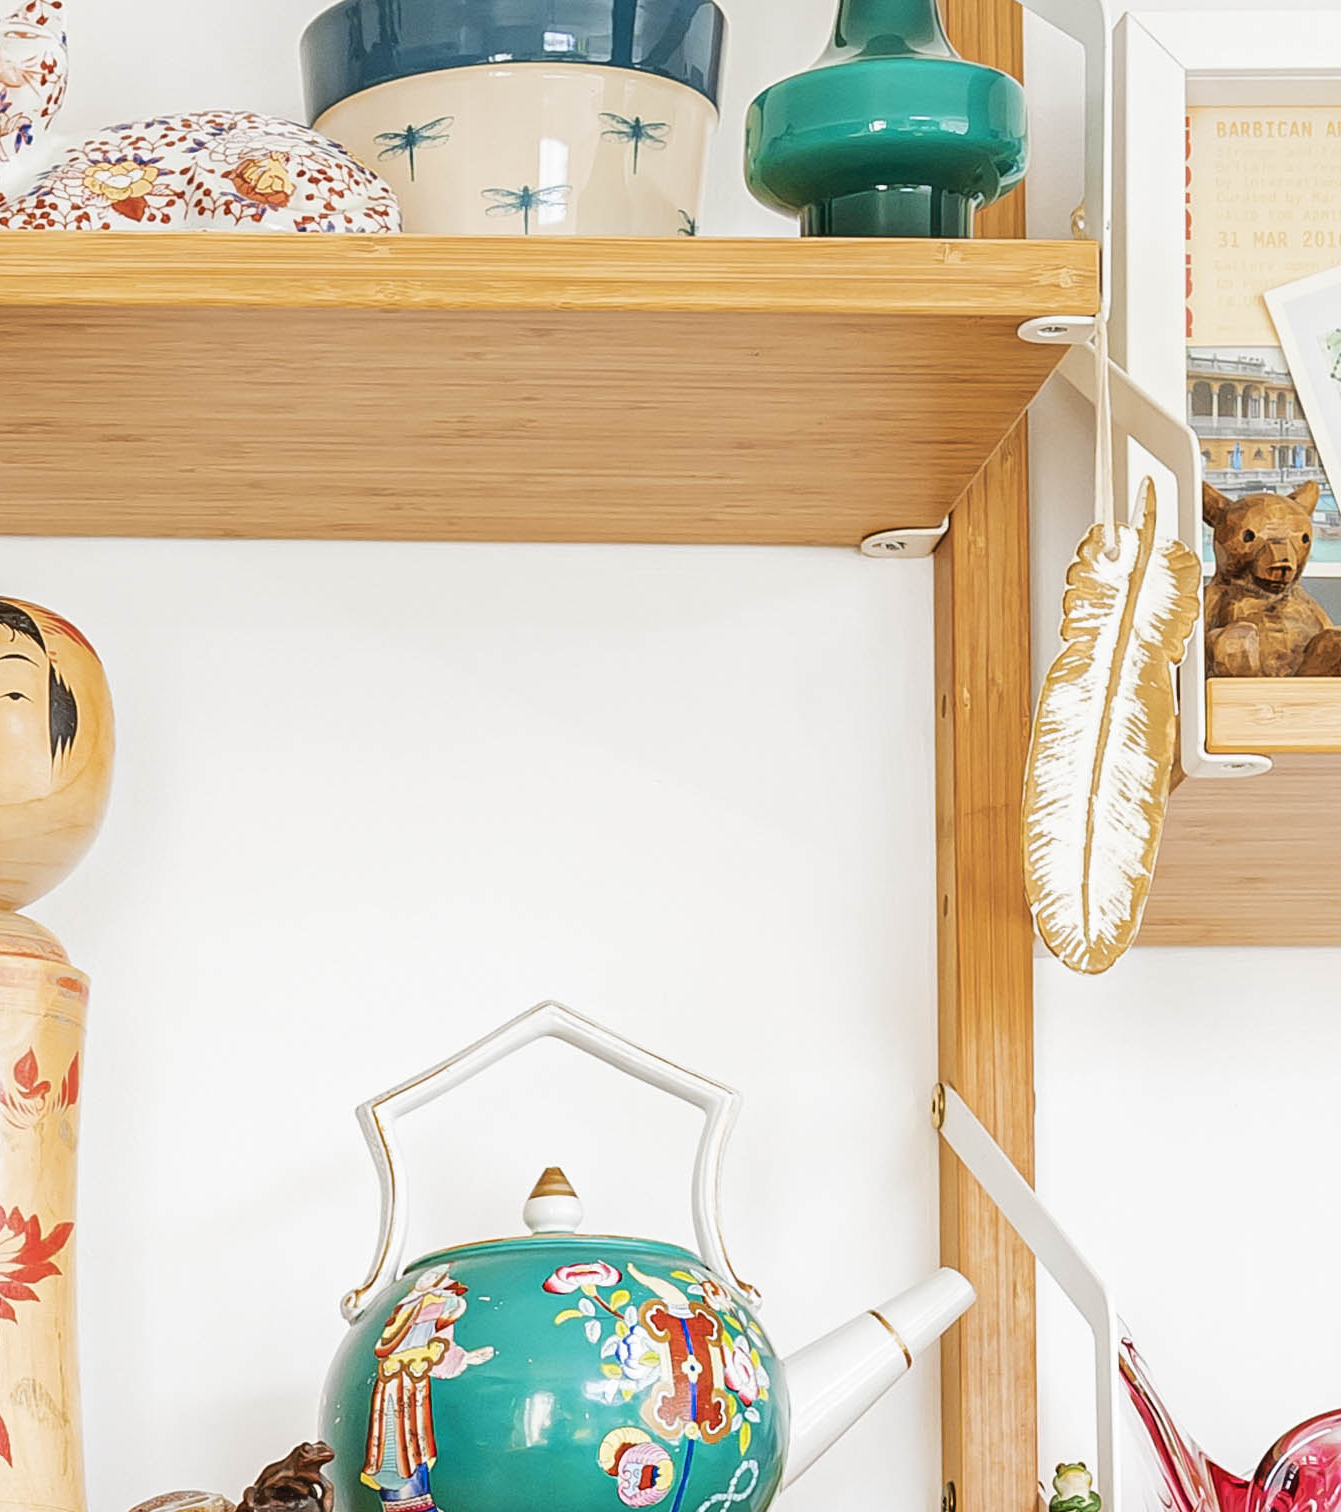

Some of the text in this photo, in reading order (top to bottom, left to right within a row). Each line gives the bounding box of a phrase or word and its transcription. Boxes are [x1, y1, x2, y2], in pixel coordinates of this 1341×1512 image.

[1216, 120, 1312, 138] BARBICAN
[1218, 231, 1238, 248] 31
[1253, 231, 1287, 248] MAR
